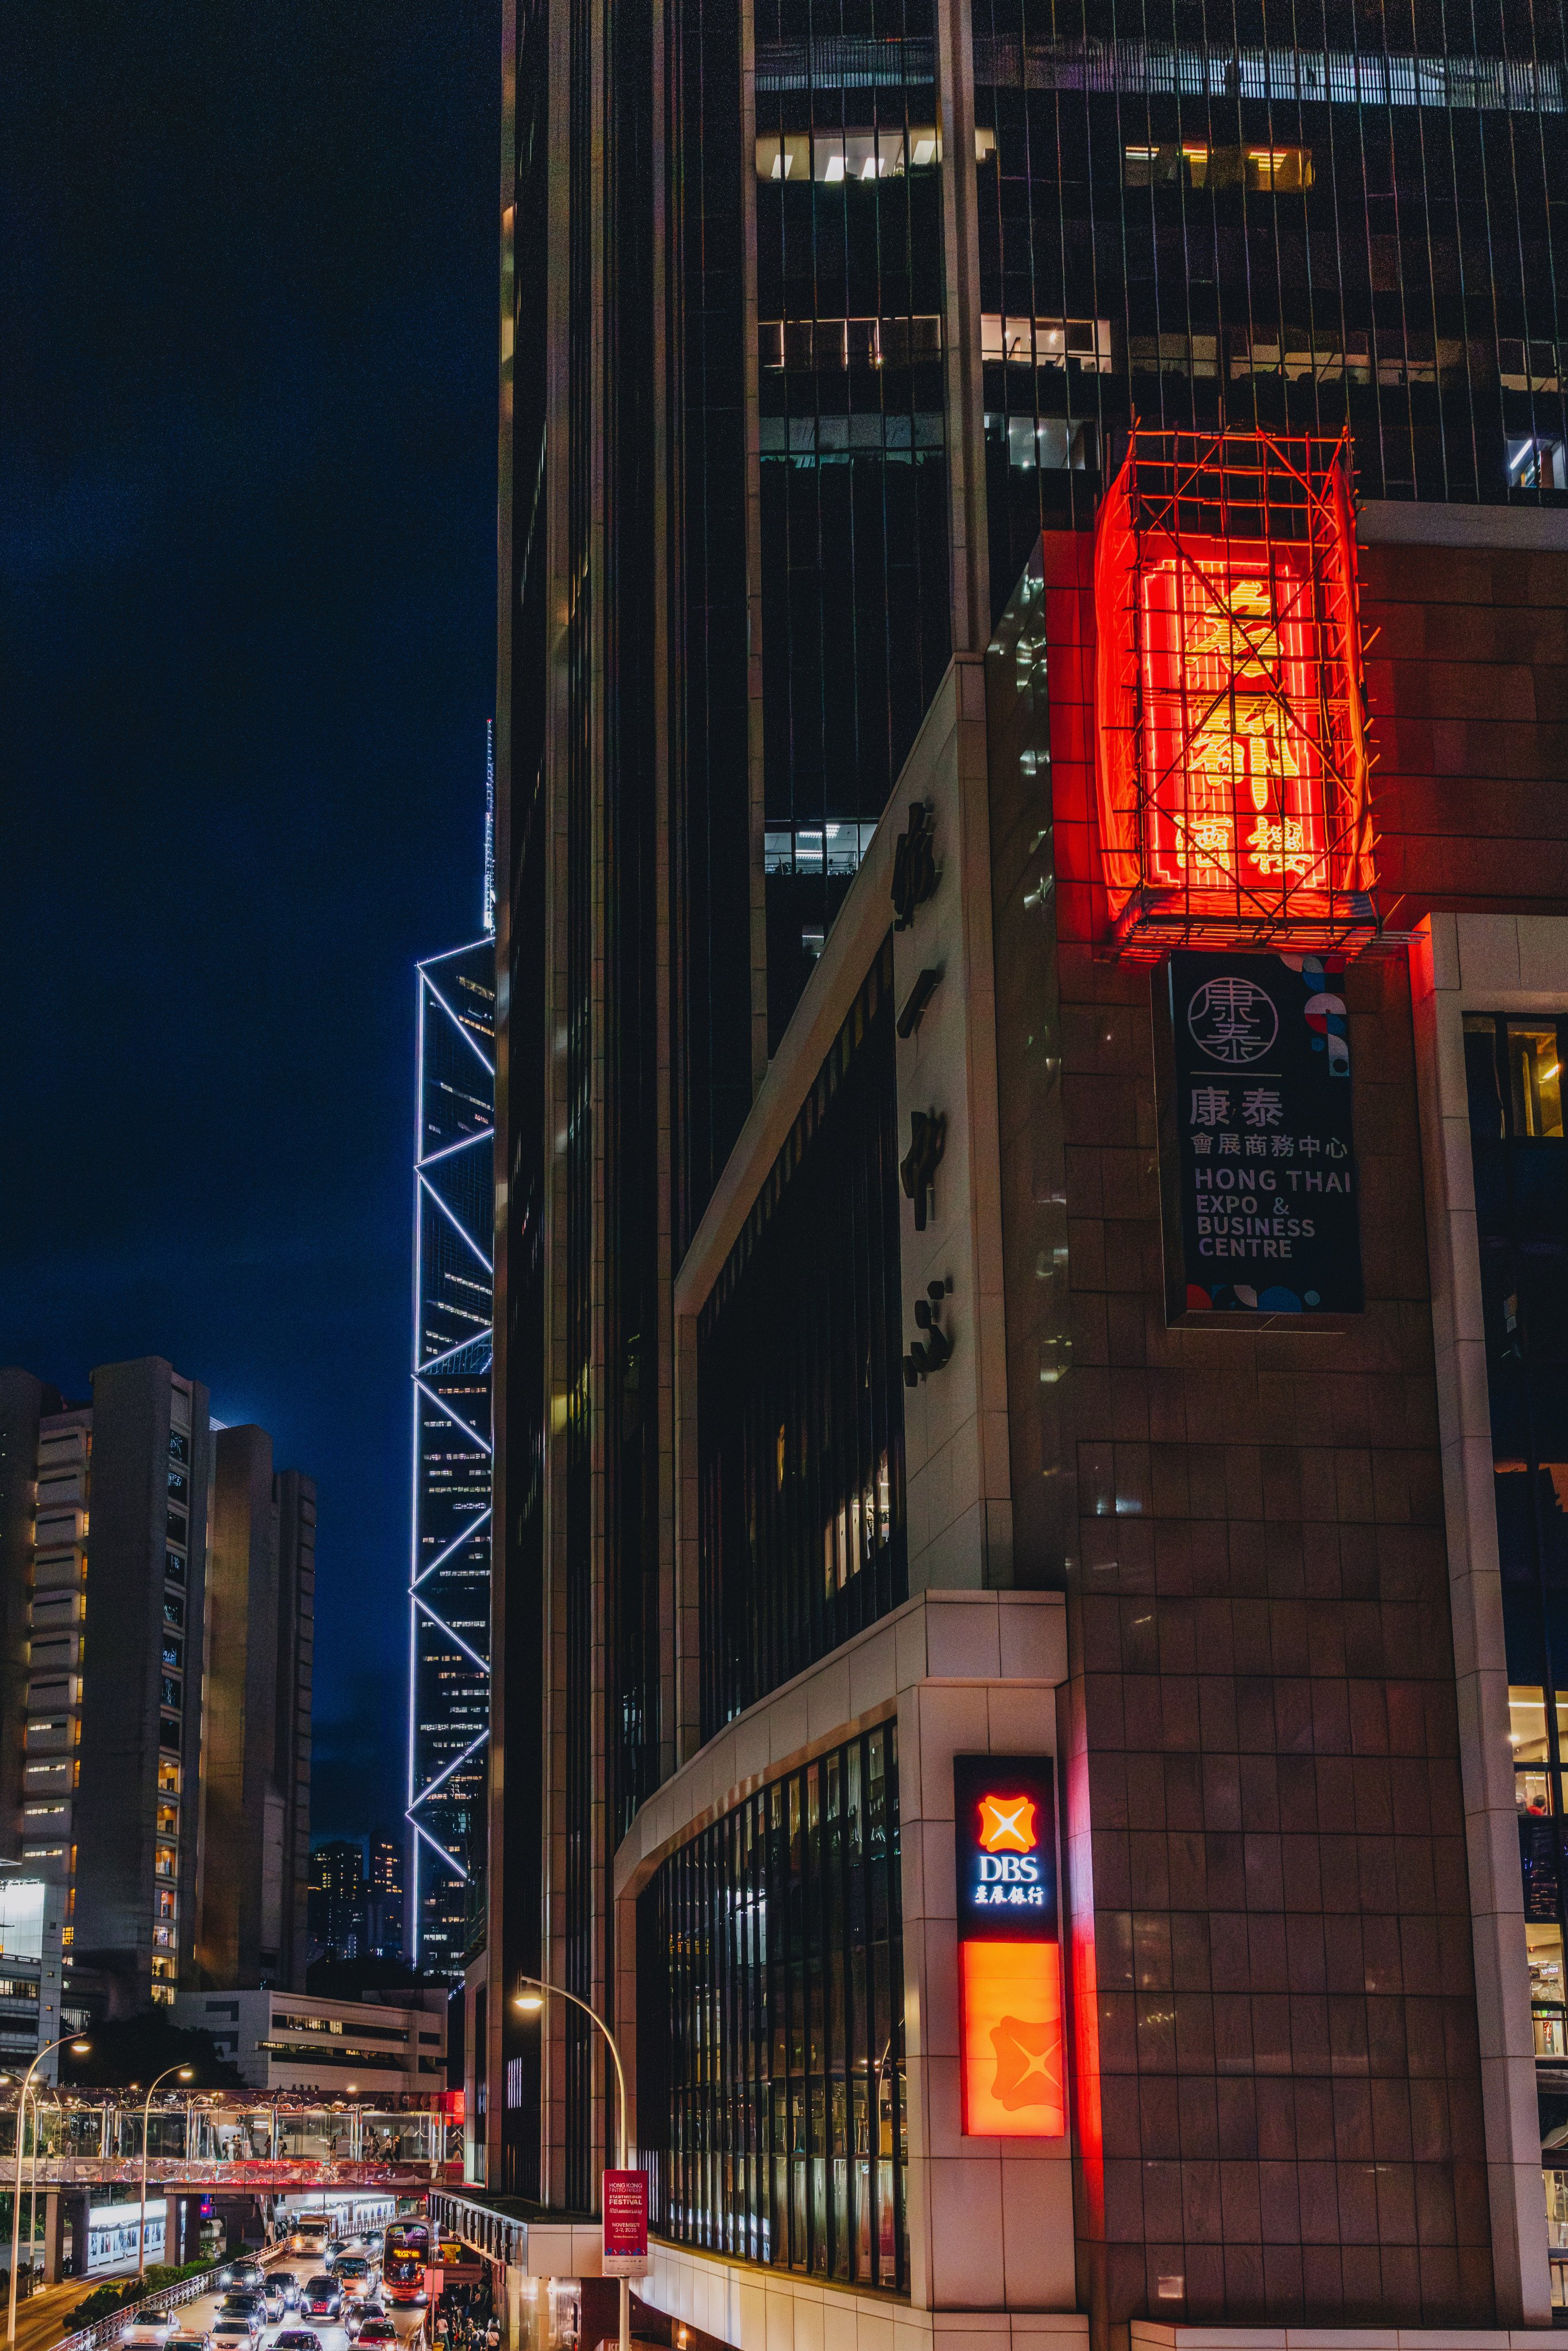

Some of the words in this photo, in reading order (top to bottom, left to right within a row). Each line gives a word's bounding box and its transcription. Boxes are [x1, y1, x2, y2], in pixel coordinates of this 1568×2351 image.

[1189, 1086, 1284, 1128] 康泰
[1190, 1132, 1349, 1160] 會展商務中心
[1195, 1168, 1277, 1191] HONG
[1286, 1169, 1352, 1194] THAI
[1196, 1194, 1259, 1215] EXPO
[1272, 1196, 1290, 1215] &
[1197, 1215, 1316, 1238] BUSINESS
[1199, 1237, 1293, 1259] CENTRE
[979, 1856, 1039, 1883] DBS
[975, 1885, 1044, 1905] 星展銀行
